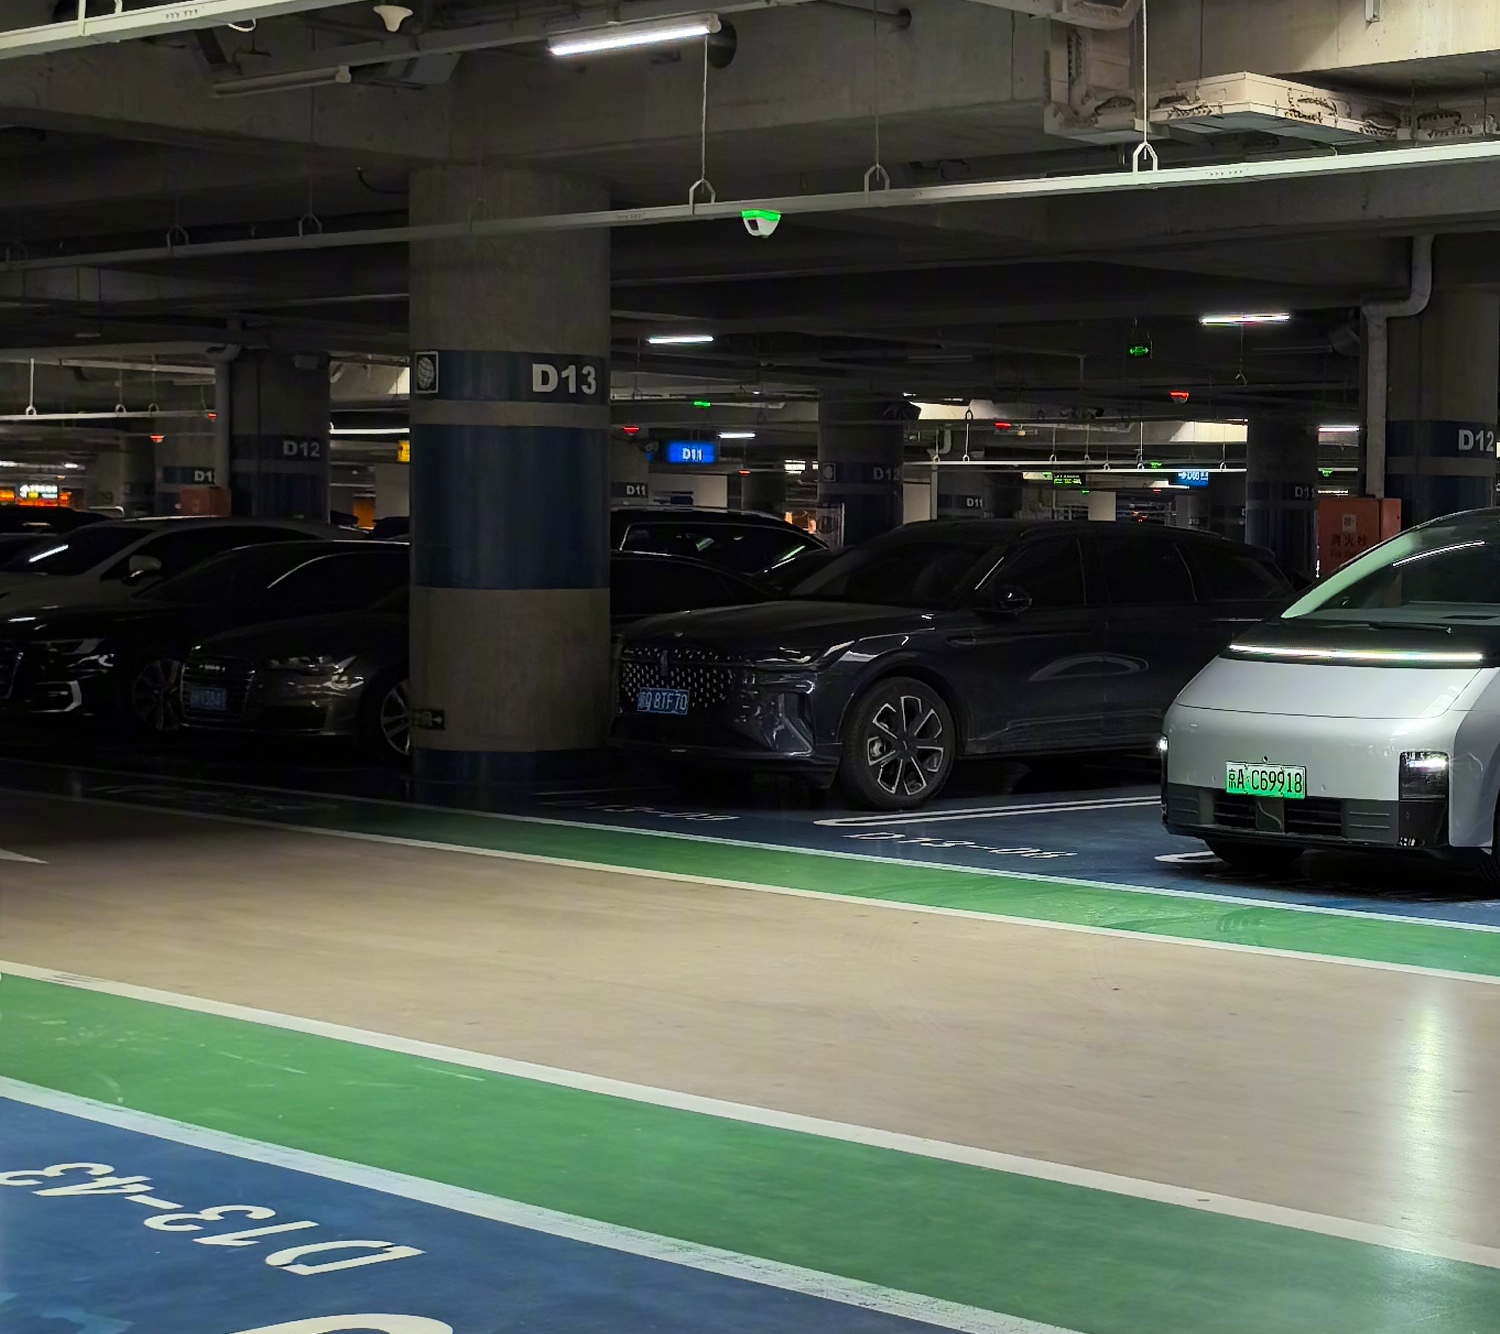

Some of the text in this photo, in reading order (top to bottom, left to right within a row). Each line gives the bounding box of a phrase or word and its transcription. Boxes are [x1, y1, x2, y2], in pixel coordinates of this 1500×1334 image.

[532, 363, 597, 395] D13
[283, 440, 322, 459] D12
[1457, 429, 1495, 452] D12
[194, 470, 215, 482] D1
